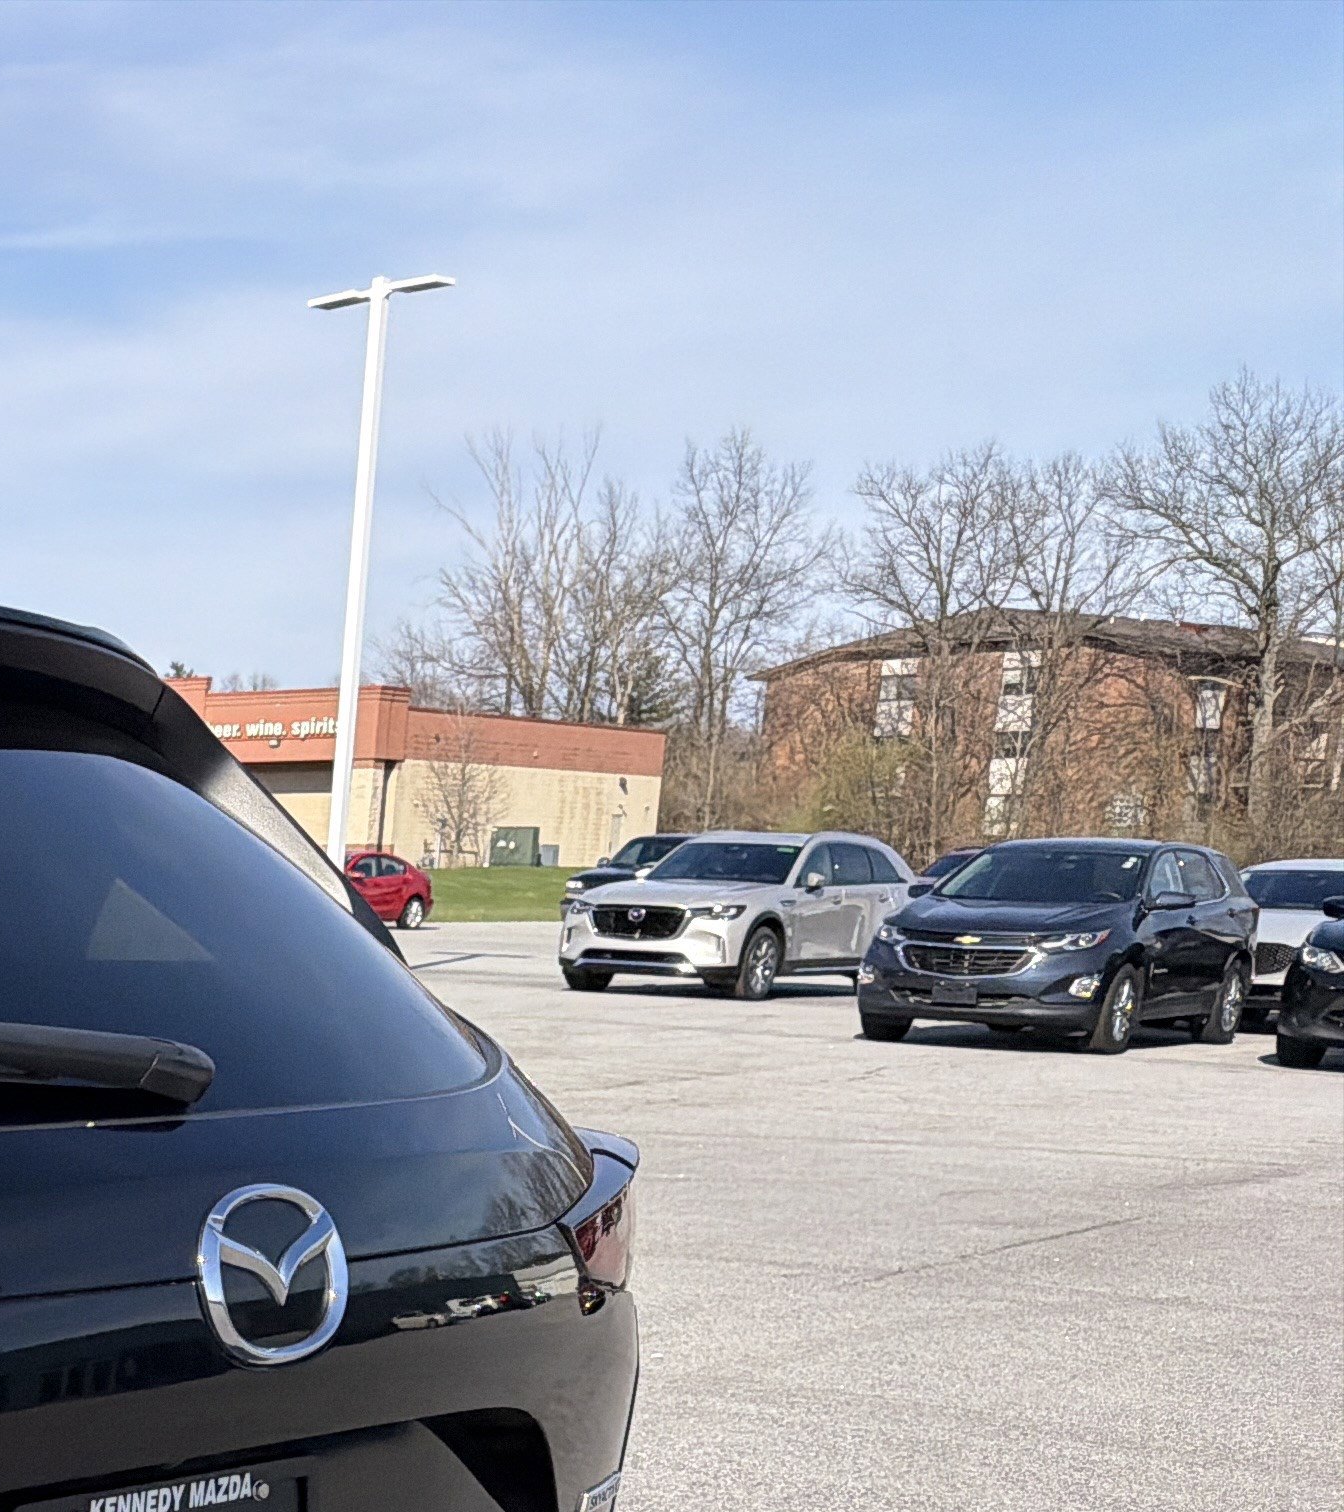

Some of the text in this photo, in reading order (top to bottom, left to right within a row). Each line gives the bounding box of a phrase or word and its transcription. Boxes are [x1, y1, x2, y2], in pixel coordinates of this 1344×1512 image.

[246, 719, 286, 737] wine.
[291, 717, 339, 740] spirit
[188, 1472, 253, 1508] MAZDA
